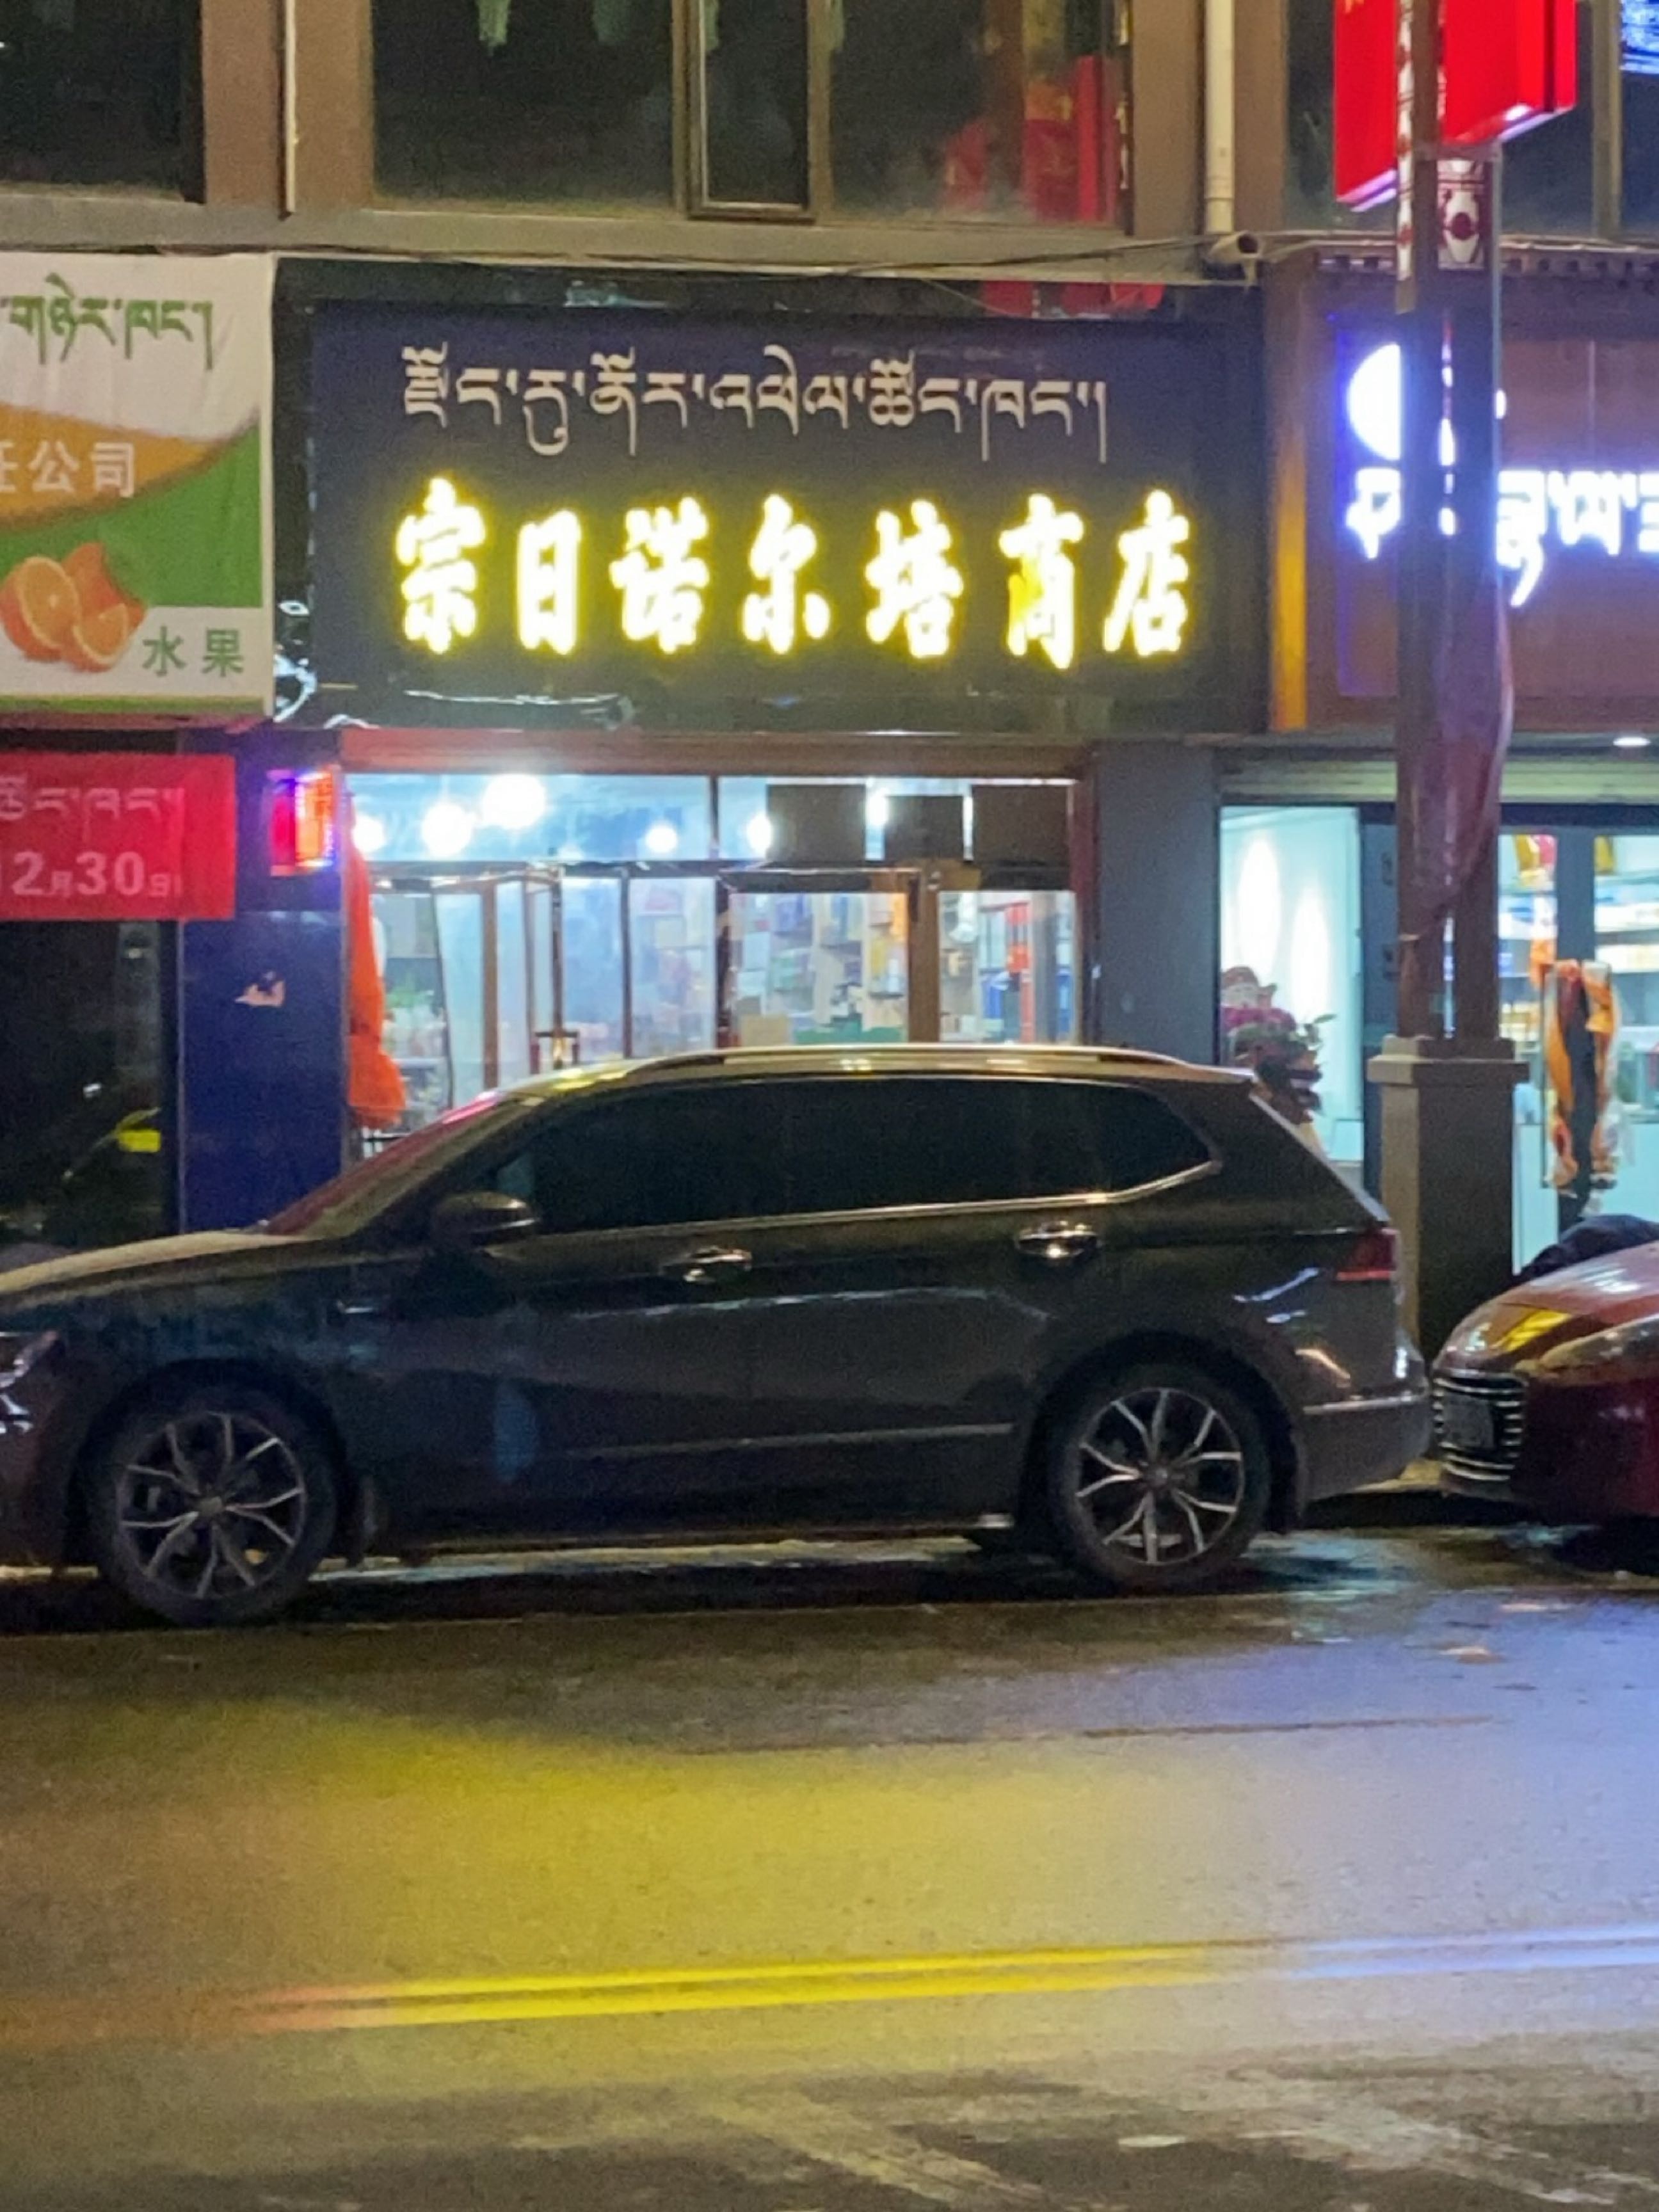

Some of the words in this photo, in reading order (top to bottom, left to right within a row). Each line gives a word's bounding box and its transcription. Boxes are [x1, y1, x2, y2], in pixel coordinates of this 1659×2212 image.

[394, 477, 1191, 670] 宗日诺尔培商店
[142, 625, 244, 678] 水果
